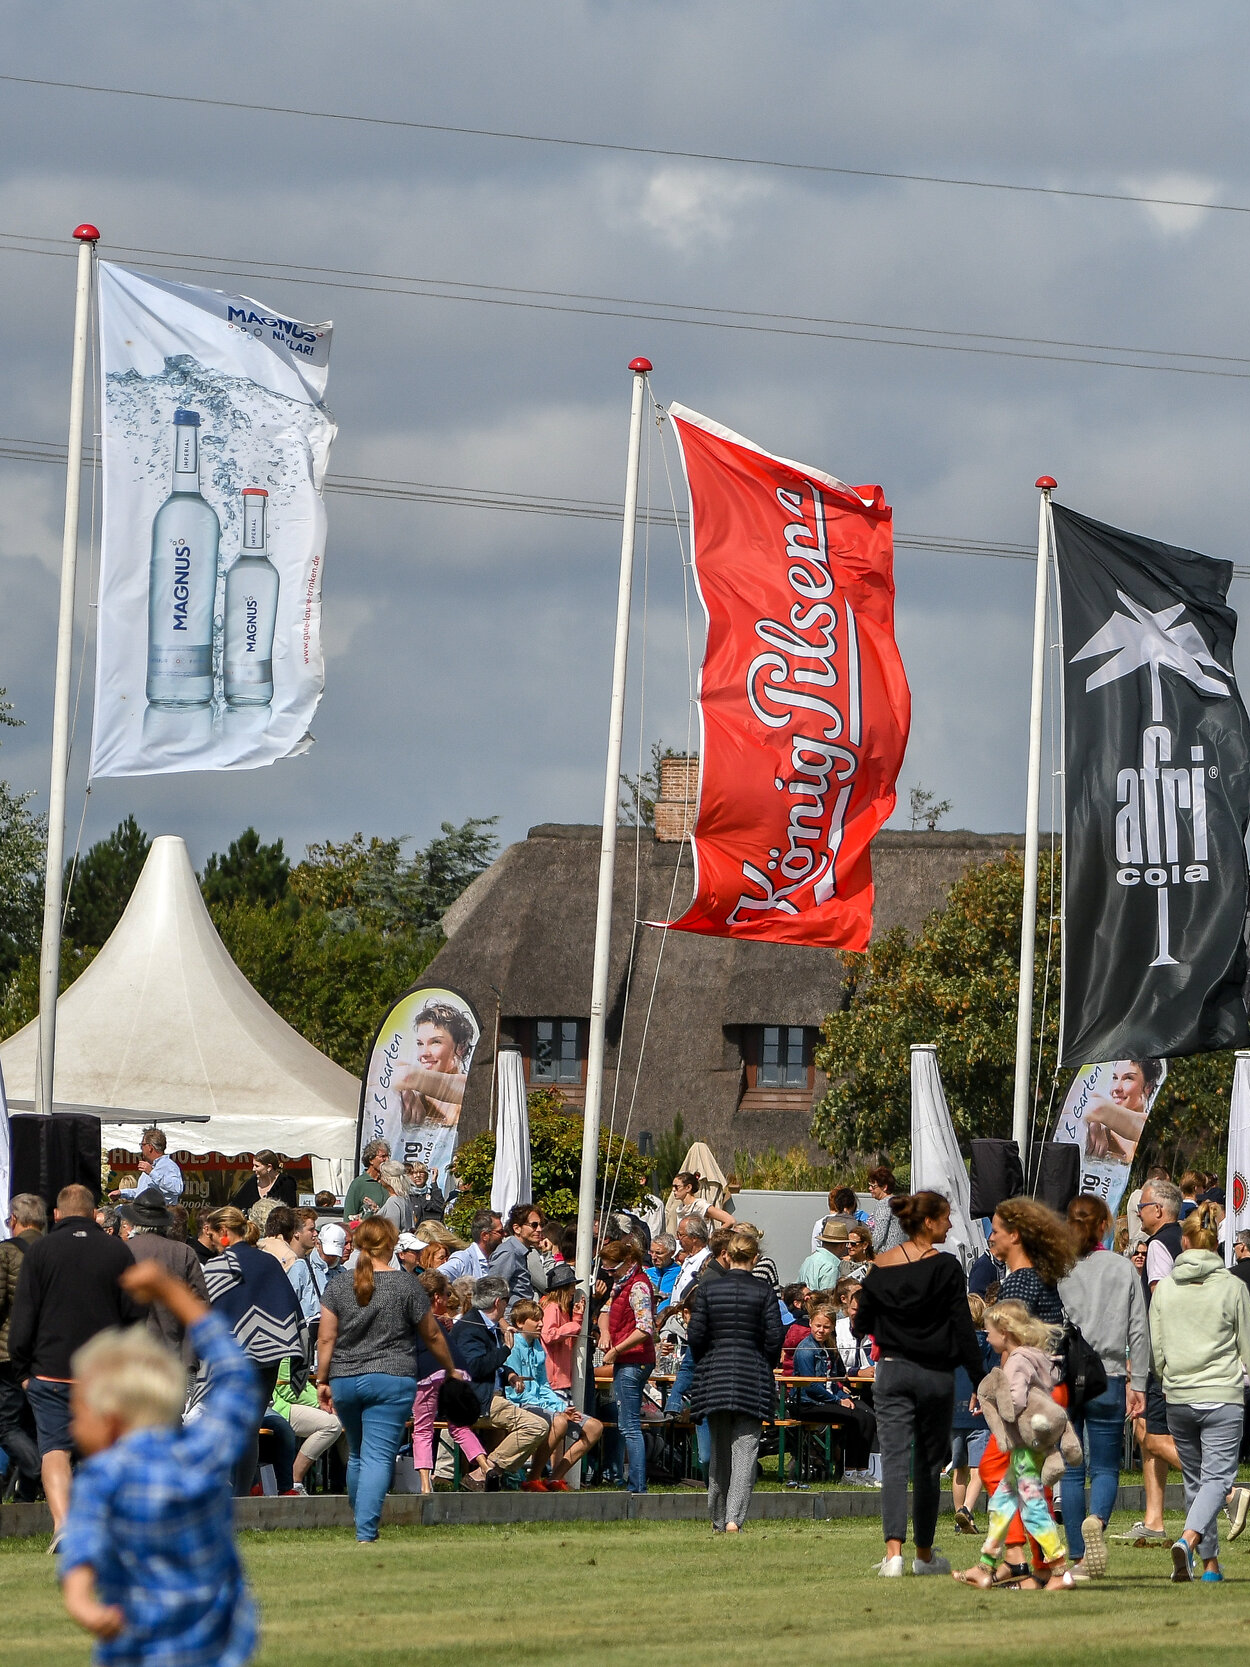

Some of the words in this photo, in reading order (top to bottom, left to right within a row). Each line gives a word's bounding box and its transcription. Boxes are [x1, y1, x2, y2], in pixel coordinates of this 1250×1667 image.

[227, 305, 317, 343] MAGNUS
[172, 546, 191, 631] MAGNUS
[246, 600, 258, 652] MAGNUS
[1115, 725, 1209, 865] afri
[725, 733, 858, 928] König
[1115, 863, 1210, 887] cola
[379, 1032, 403, 1090] Garten
[1073, 1065, 1102, 1119] Garten
